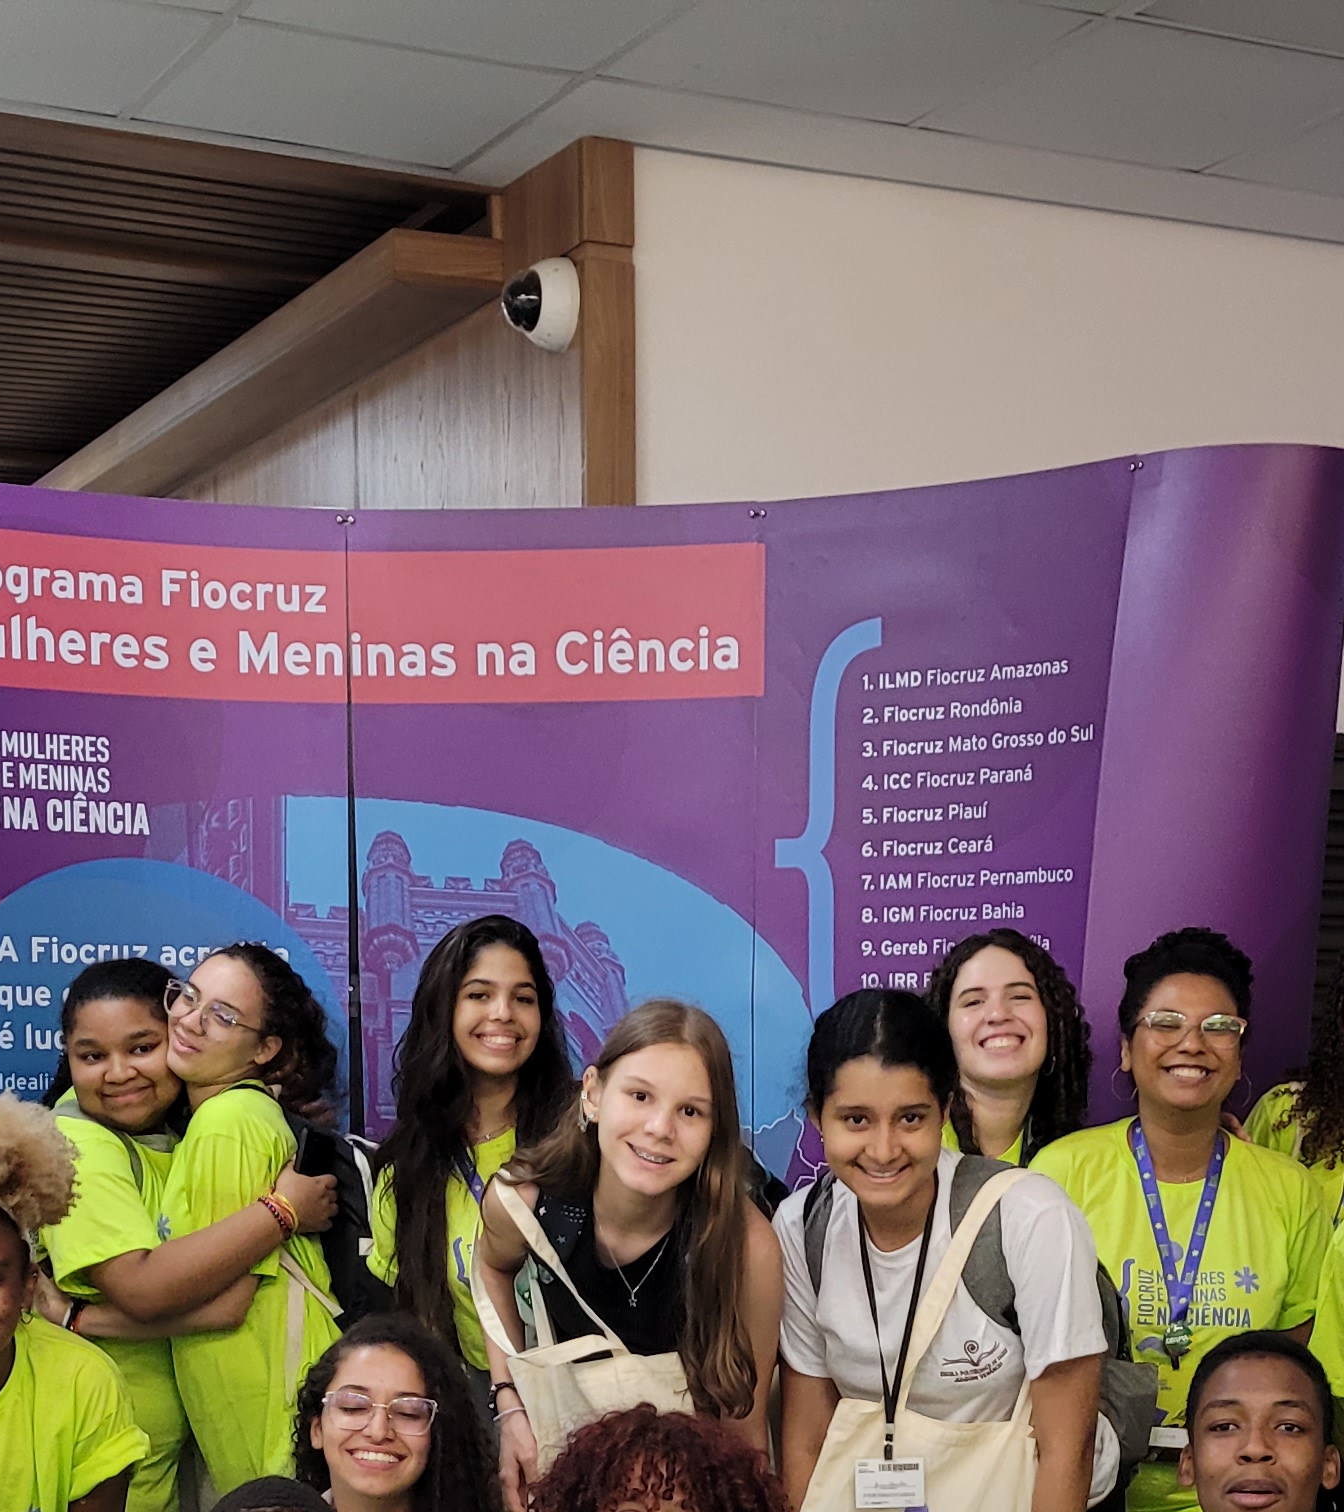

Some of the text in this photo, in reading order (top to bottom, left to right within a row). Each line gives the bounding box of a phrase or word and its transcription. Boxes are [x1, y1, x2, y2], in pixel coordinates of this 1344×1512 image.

[161, 569, 327, 613] Fiocruz
[189, 638, 216, 672] e
[239, 631, 456, 676] Meninas
[477, 641, 536, 676] na
[556, 626, 739, 675] Ciência
[862, 659, 1069, 691] 1. ILMD Fiocruz Amazonas
[862, 697, 1023, 725] 2. Fiocruz Rondônia
[1, 731, 110, 763] MULHERES
[862, 724, 1094, 758] 3. Fiocruz Mato Grosso do Sul
[2, 761, 110, 793] E MENINAS
[862, 763, 1033, 791] 4. ICC Fiocruz Paraná
[3, 791, 150, 836] NA CIÊNCIA
[862, 801, 988, 824] 5. Fiocruz Piauí
[861, 835, 993, 857] 6. Fiocruz Ceará
[861, 867, 1074, 891] 7. IAM Fiocruz Pernambuco
[861, 902, 1025, 923] 8. IGM Fiocruz Bahia
[31, 936, 148, 965] Fiocruz
[861, 941, 877, 956] 9.
[881, 940, 928, 956] Gereb
[889, 972, 918, 989] IRR
[1137, 1268, 1154, 1326] FIOCRUZ
[1157, 1287, 1164, 1301] E
